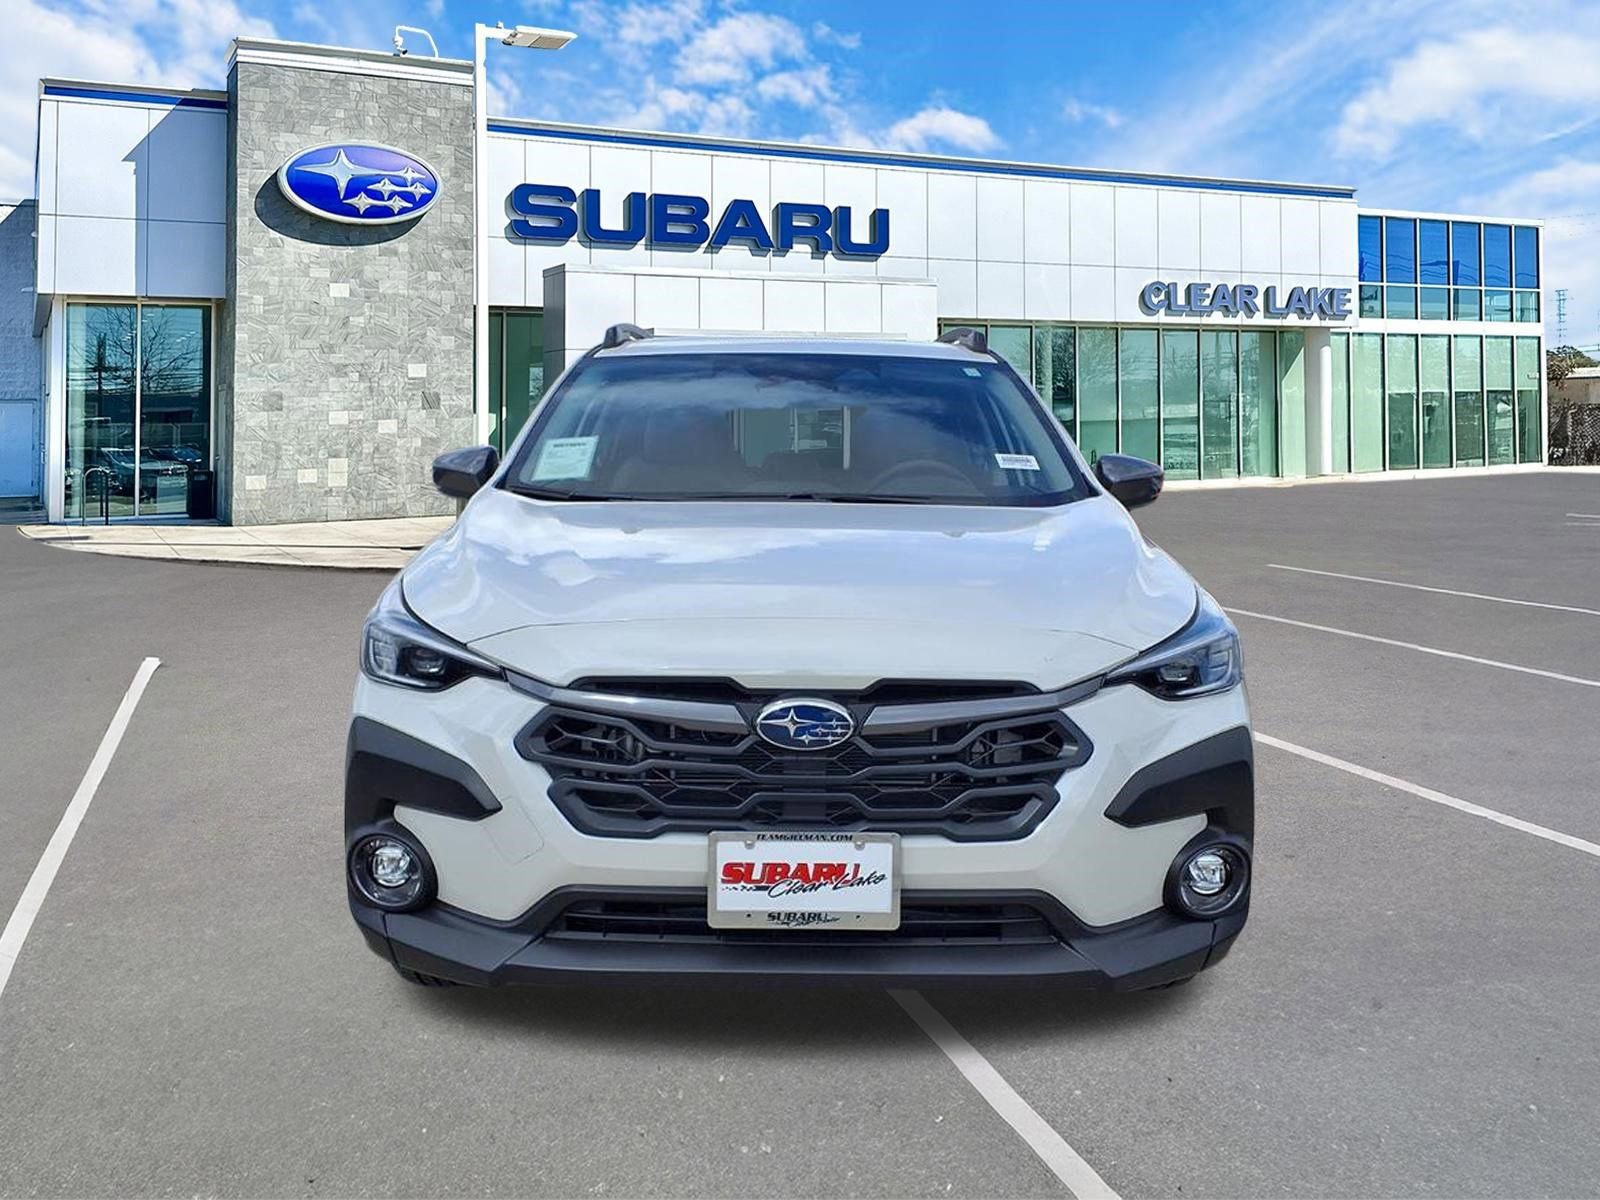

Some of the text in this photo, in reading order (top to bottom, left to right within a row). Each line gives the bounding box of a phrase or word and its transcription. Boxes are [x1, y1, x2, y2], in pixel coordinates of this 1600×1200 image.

[506, 183, 890, 257] SUBARU
[1139, 281, 1353, 320] CLEAR LAKE
[721, 862, 860, 885] SUBARU
[768, 871, 888, 898] Clear Lake
[767, 911, 829, 922] SUBARU
